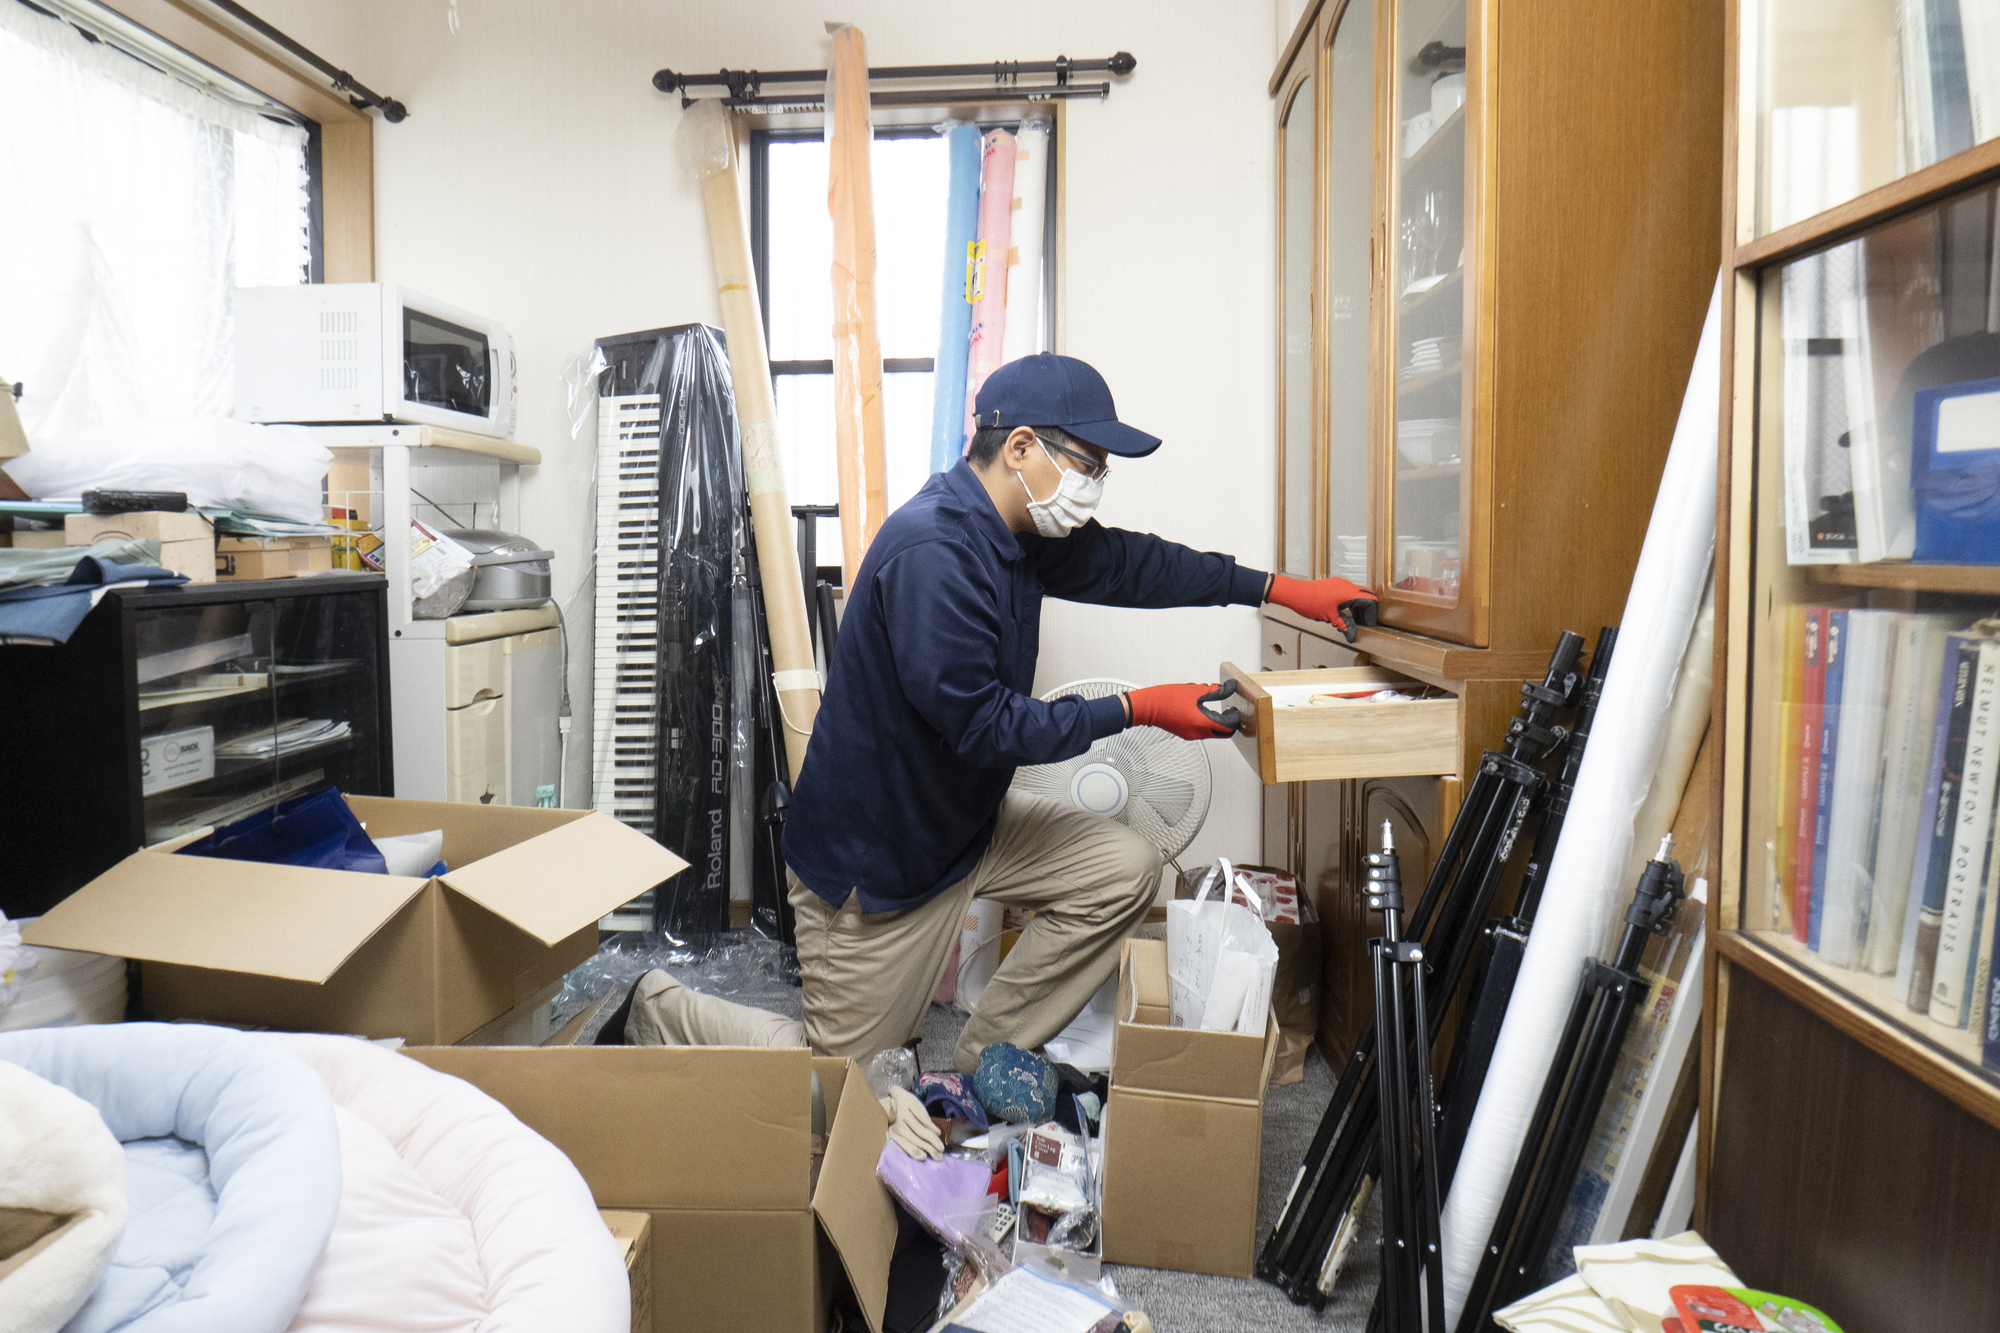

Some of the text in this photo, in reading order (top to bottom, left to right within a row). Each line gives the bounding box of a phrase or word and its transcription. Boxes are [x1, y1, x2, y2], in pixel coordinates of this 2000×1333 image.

[1975, 663, 1996, 738] HELMUT
[707, 677, 724, 891] Roland RD-300NX
[1963, 745, 1984, 826] NEWTON
[1943, 843, 1970, 954] PORTRAITS
